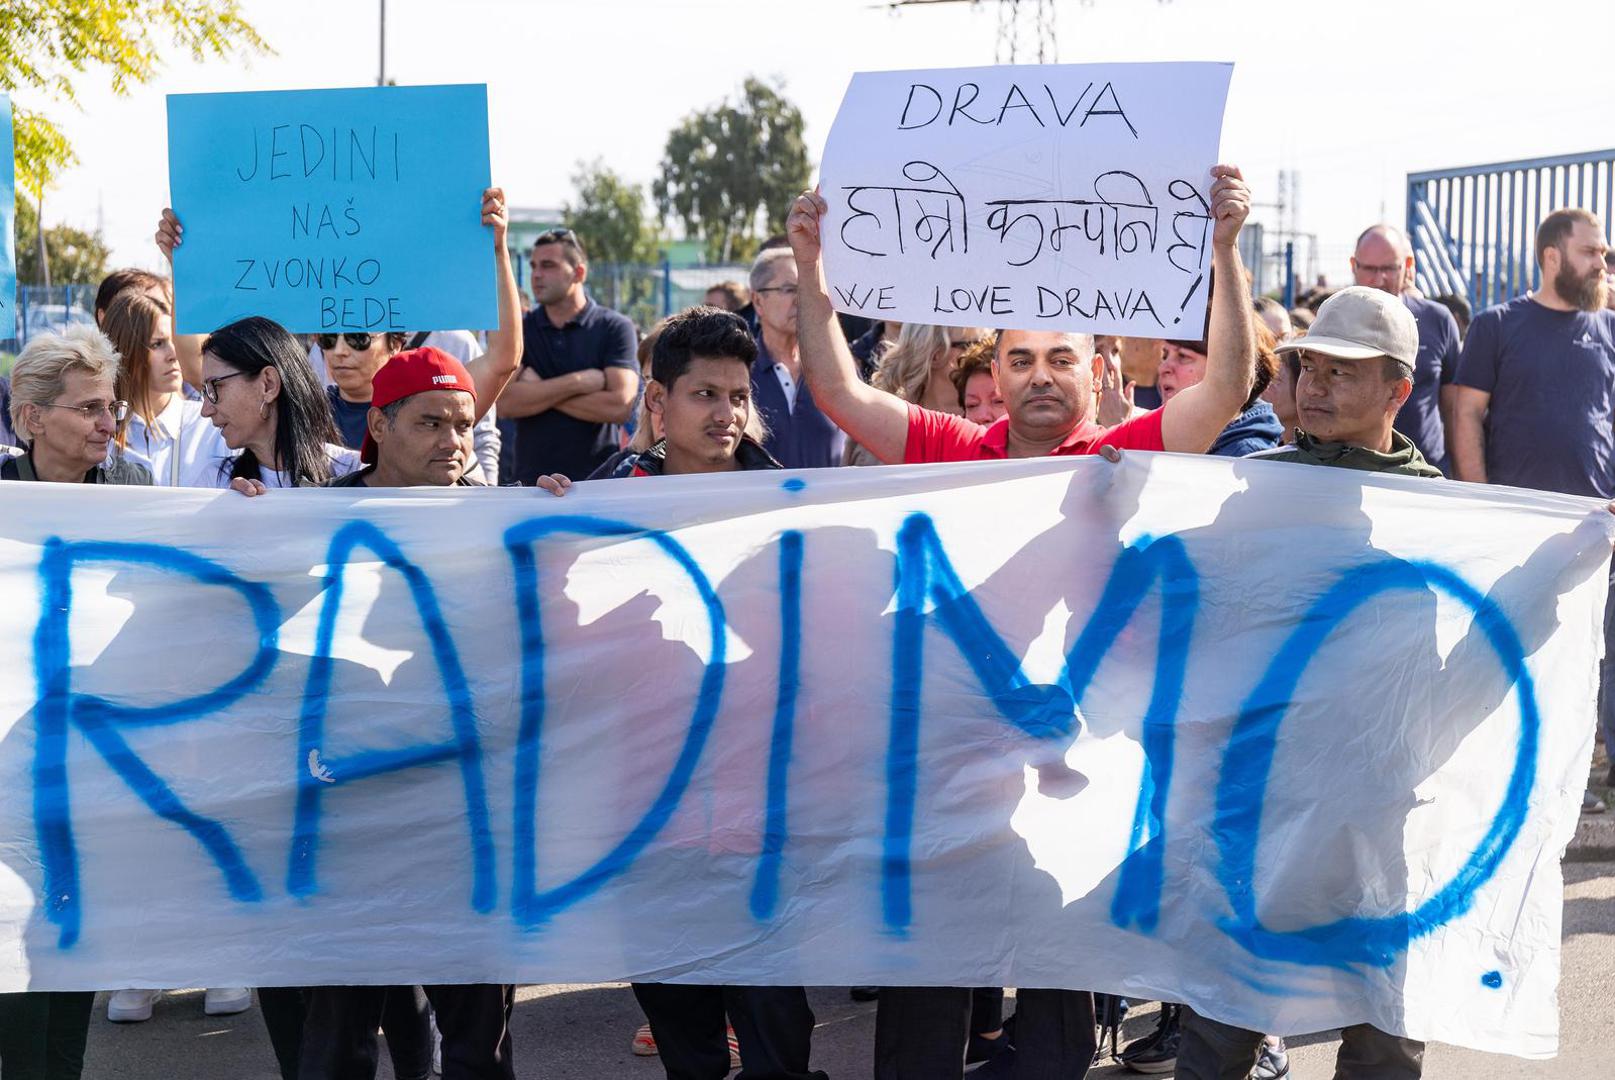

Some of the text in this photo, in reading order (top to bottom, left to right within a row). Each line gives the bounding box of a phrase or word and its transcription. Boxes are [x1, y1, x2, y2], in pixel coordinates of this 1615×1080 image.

[896, 80, 1139, 139] DRAVA
[236, 123, 399, 183] JEDINI
[292, 196, 361, 240] NAŠ
[840, 159, 969, 261] हाम्रो
[234, 255, 381, 291] ZVONKO
[321, 296, 406, 329] BEDE
[833, 283, 897, 311] WE
[933, 284, 1015, 315] LOVE
